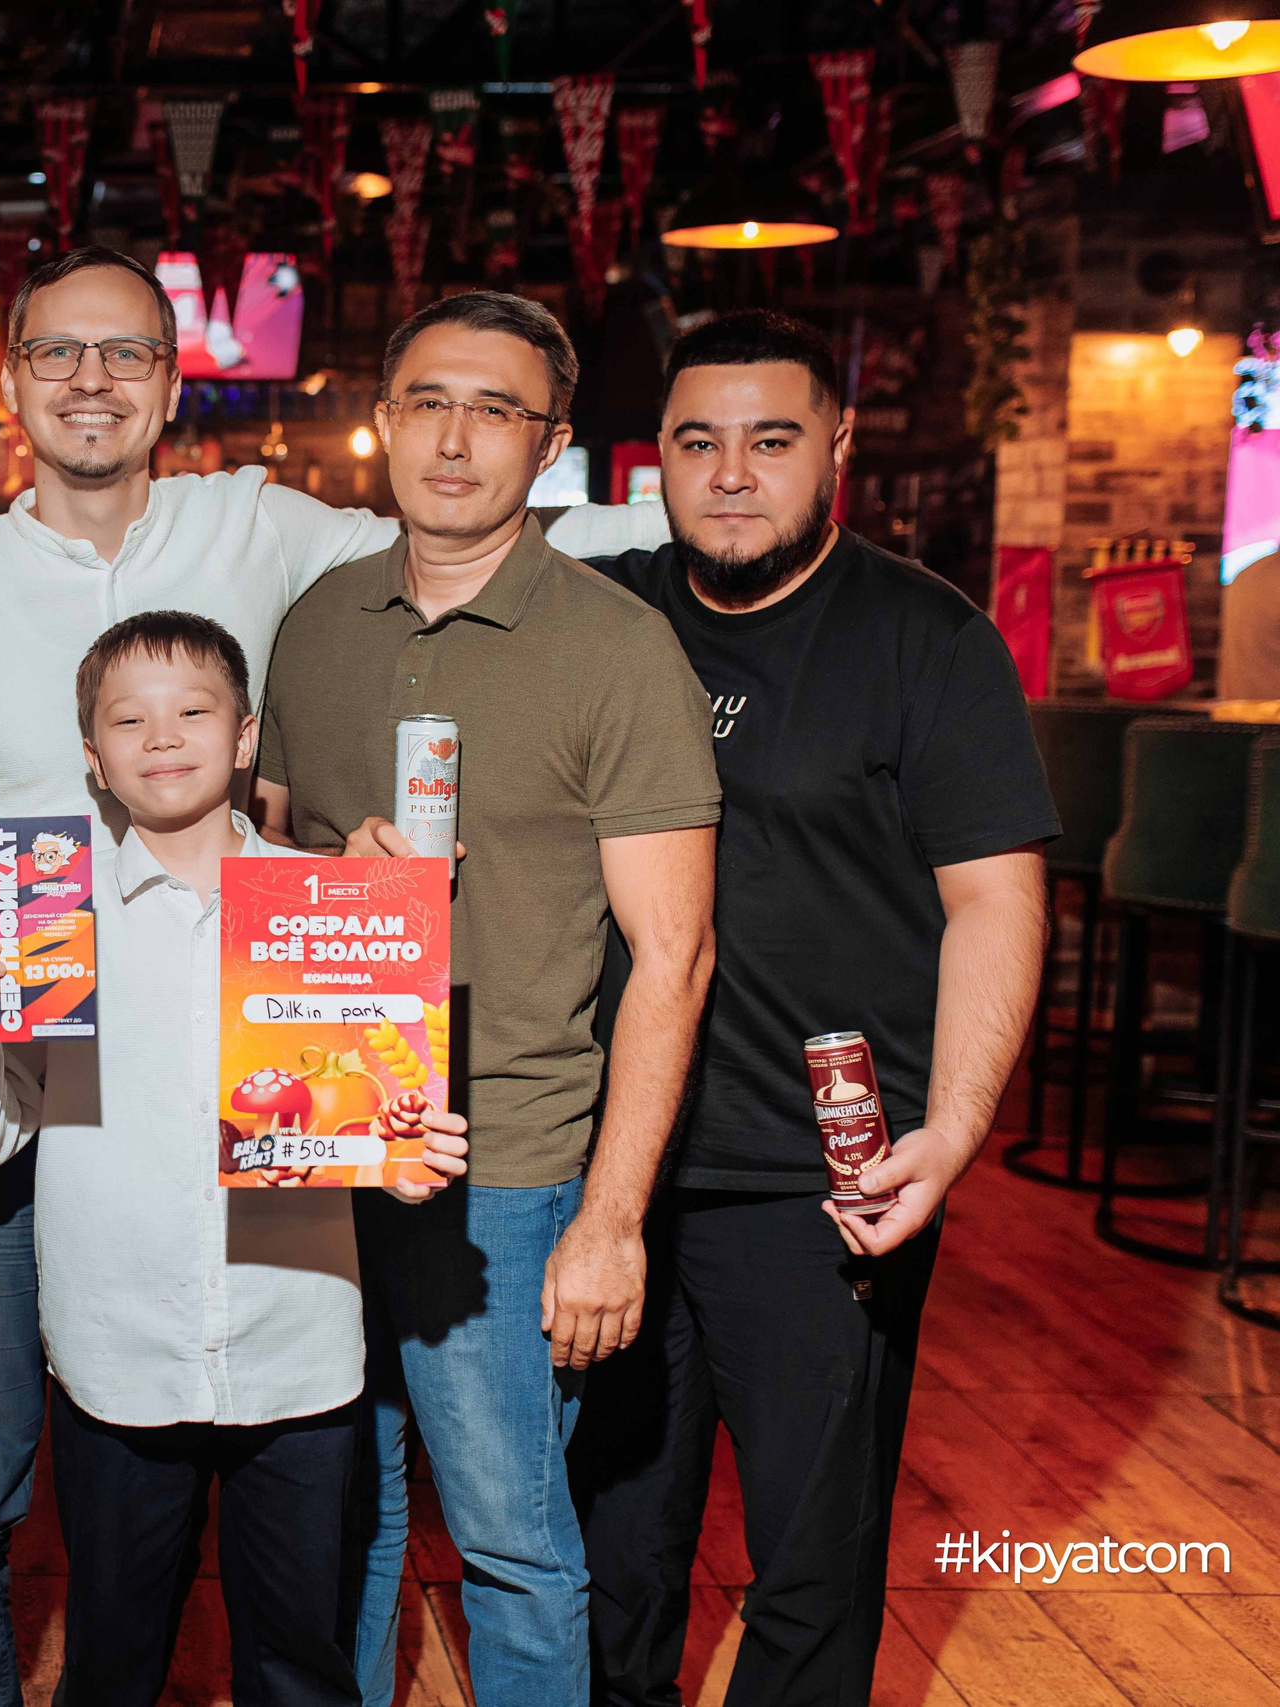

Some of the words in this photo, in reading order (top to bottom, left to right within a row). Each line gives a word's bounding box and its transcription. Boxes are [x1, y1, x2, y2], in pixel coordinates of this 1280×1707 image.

[303, 875, 319, 905] 1
[328, 887, 360, 896] МЕСТО
[268, 915, 405, 937] СОБРАЛИ
[250, 936, 305, 962] ВСЁ
[310, 941, 422, 963] ЗОЛОТО
[24, 964, 45, 979] 13
[46, 963, 85, 979] 000
[302, 973, 373, 985] КОМАНДА
[341, 1003, 387, 1026] park
[829, 1132, 873, 1150] Pilsner
